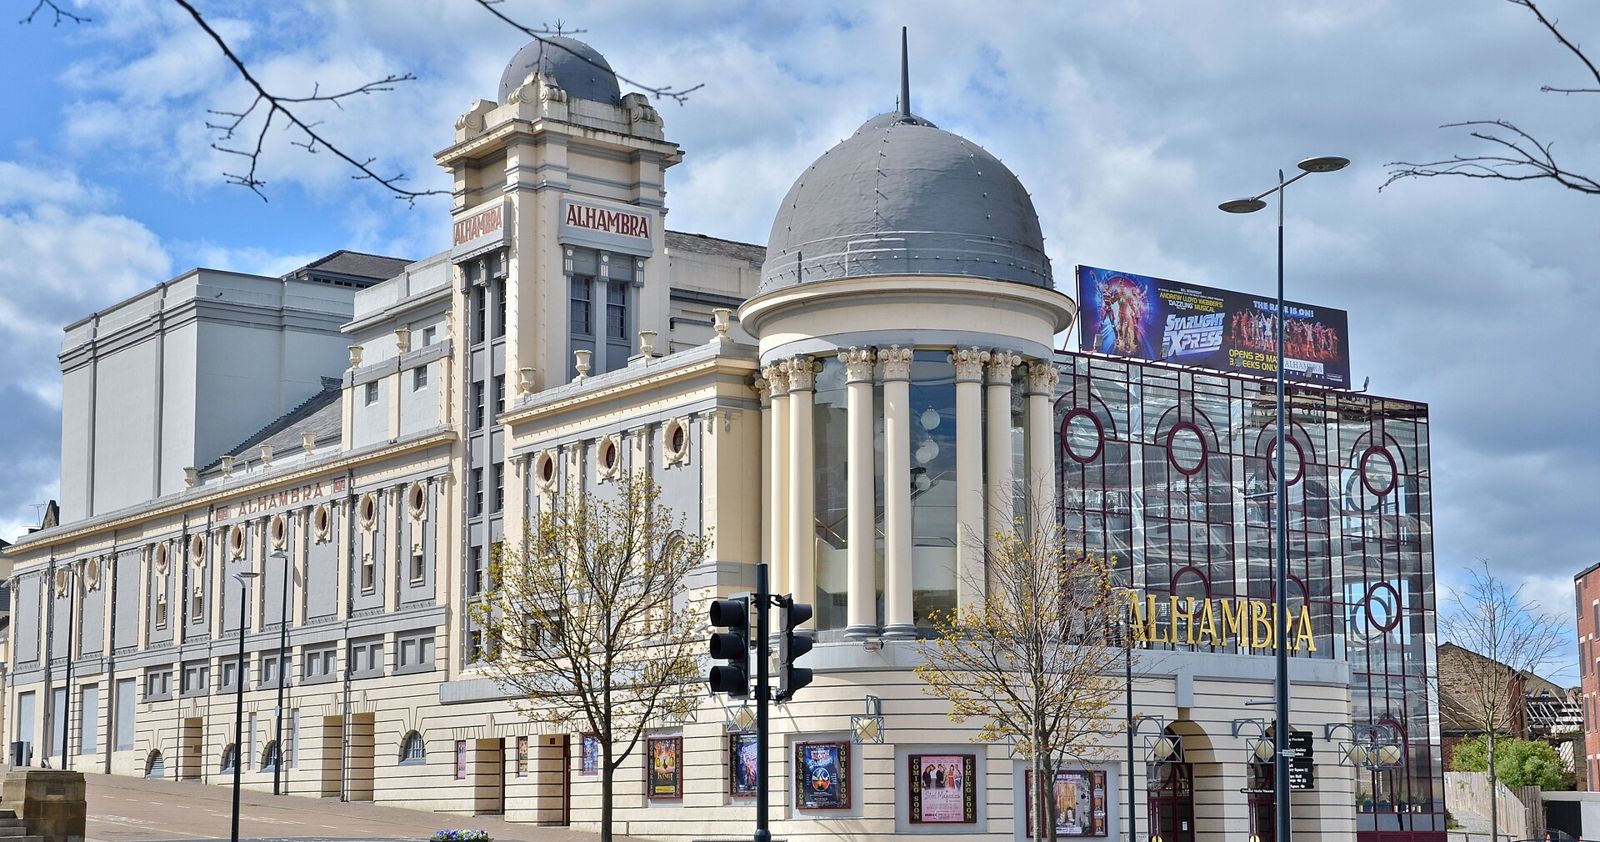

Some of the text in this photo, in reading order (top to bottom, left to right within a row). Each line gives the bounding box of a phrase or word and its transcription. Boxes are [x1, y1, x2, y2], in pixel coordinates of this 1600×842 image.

[454, 205, 502, 245] ALHAMBRA
[566, 204, 649, 239] ALHAMBRA
[1159, 292, 1183, 301] ANDREW
[1182, 294, 1198, 303] LLOYD
[1168, 299, 1193, 309] DAZZLING
[1194, 303, 1216, 313] MUSICAL
[1253, 300, 1314, 318] THE RAE IS ON!
[1165, 312, 1226, 332] STARLIGHT
[1228, 349, 1279, 364] OPENS 29 MA
[1229, 357, 1234, 366] 3
[1235, 358, 1260, 370] EEKS
[238, 482, 323, 517] ALHAMBRA
[912, 758, 920, 793] COMING
